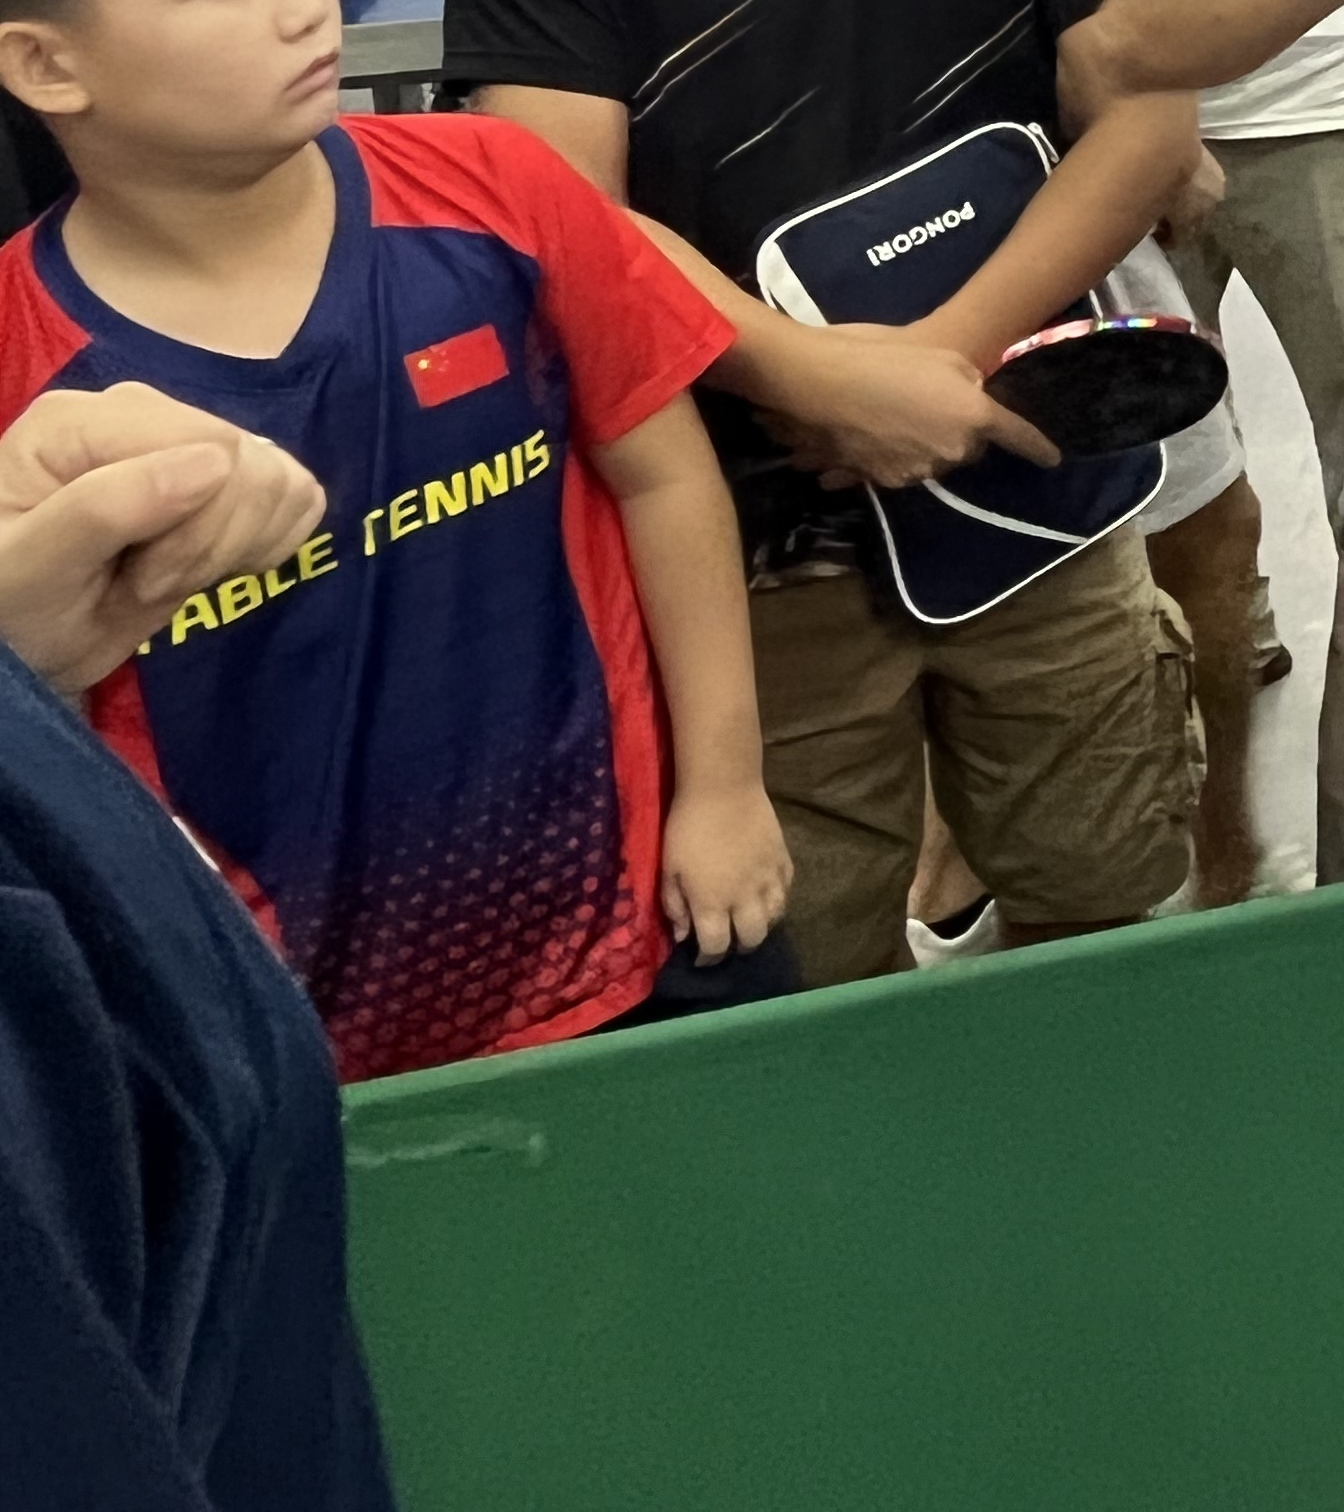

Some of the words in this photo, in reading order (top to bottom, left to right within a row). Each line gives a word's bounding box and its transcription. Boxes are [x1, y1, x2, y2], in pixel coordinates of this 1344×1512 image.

[866, 201, 976, 267] PONGORI
[136, 532, 339, 656] ABLE
[364, 429, 551, 557] TENNIS
